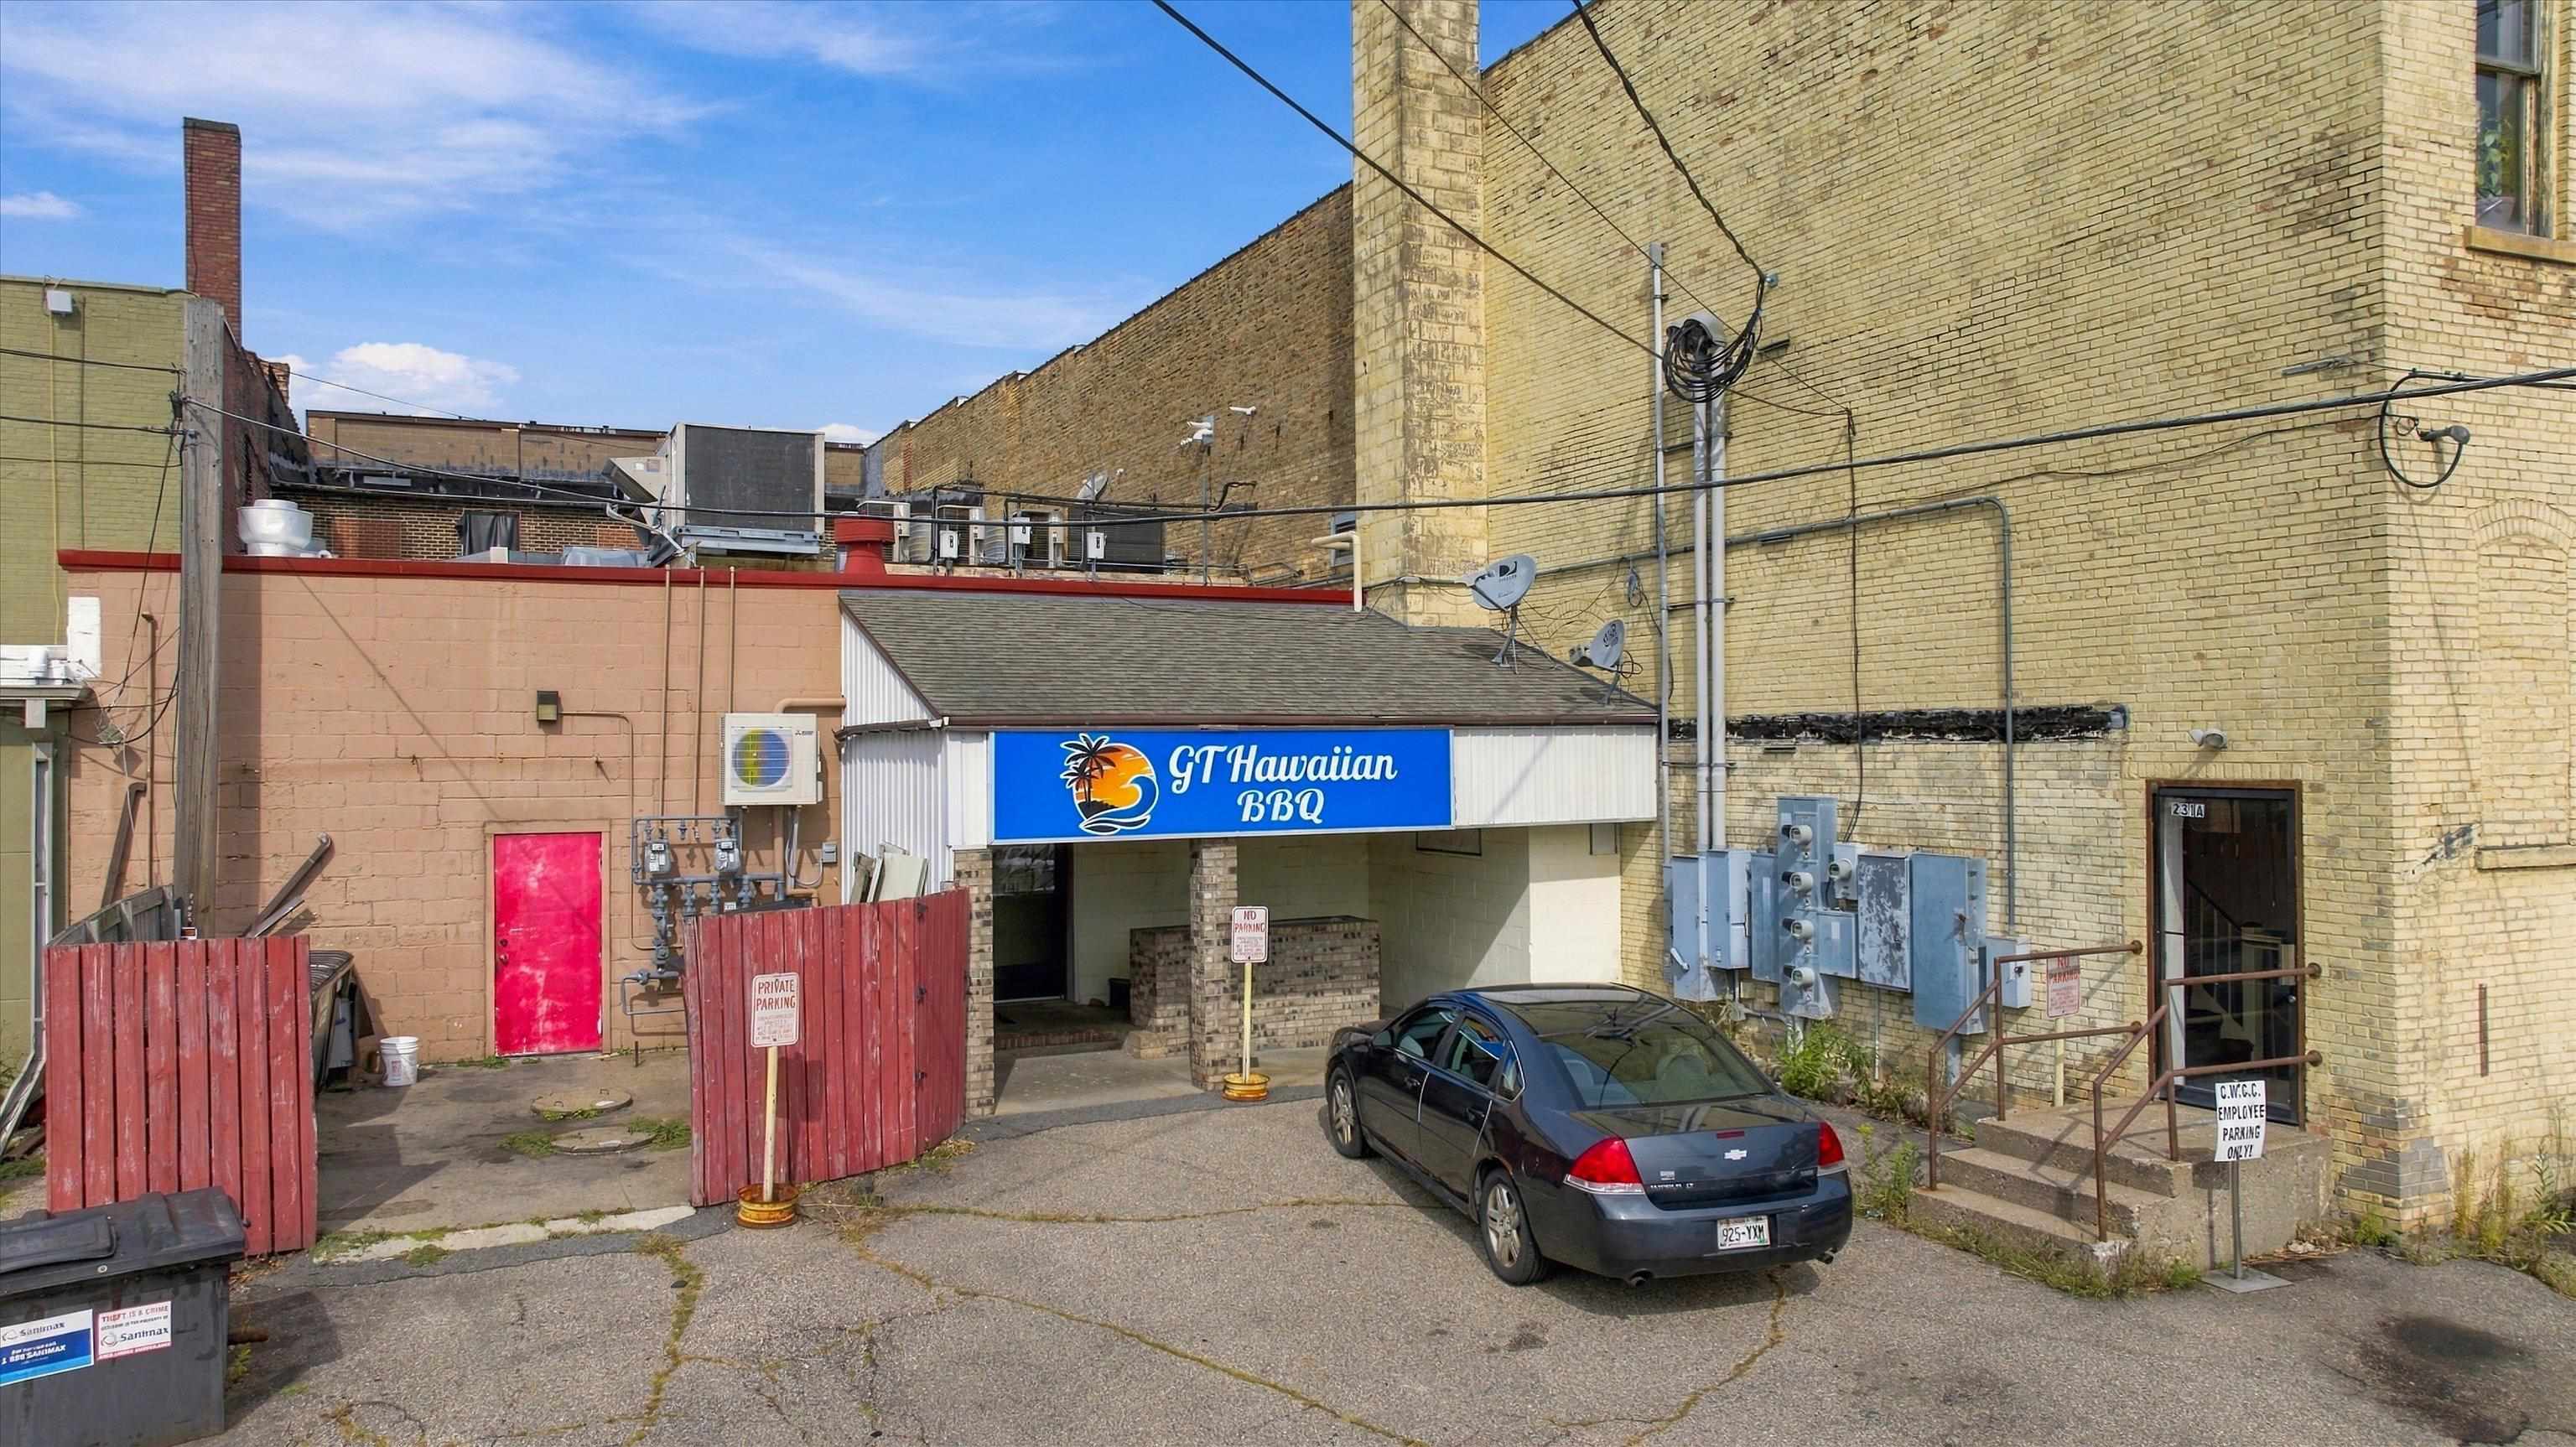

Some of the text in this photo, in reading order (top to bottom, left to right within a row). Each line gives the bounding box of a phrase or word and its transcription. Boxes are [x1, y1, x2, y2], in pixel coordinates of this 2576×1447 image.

[1168, 744, 1398, 794] GT Hawaiian
[1237, 788, 1325, 824] BBQ
[2173, 803, 2204, 817] 231A
[1244, 910, 1257, 921] NO
[1235, 922, 1265, 933] PARKING
[758, 979, 795, 995] PRIVATE
[756, 995, 796, 1012] PARKING
[2218, 1104, 2265, 1121] EMPLOYEE
[2222, 1125, 2261, 1141] PARKING
[2227, 1144, 2254, 1159] ONLY!
[19, 1322, 65, 1336] Sanimax
[120, 1327, 169, 1342] Sanimax
[26, 1344, 66, 1359] SANIMAX
